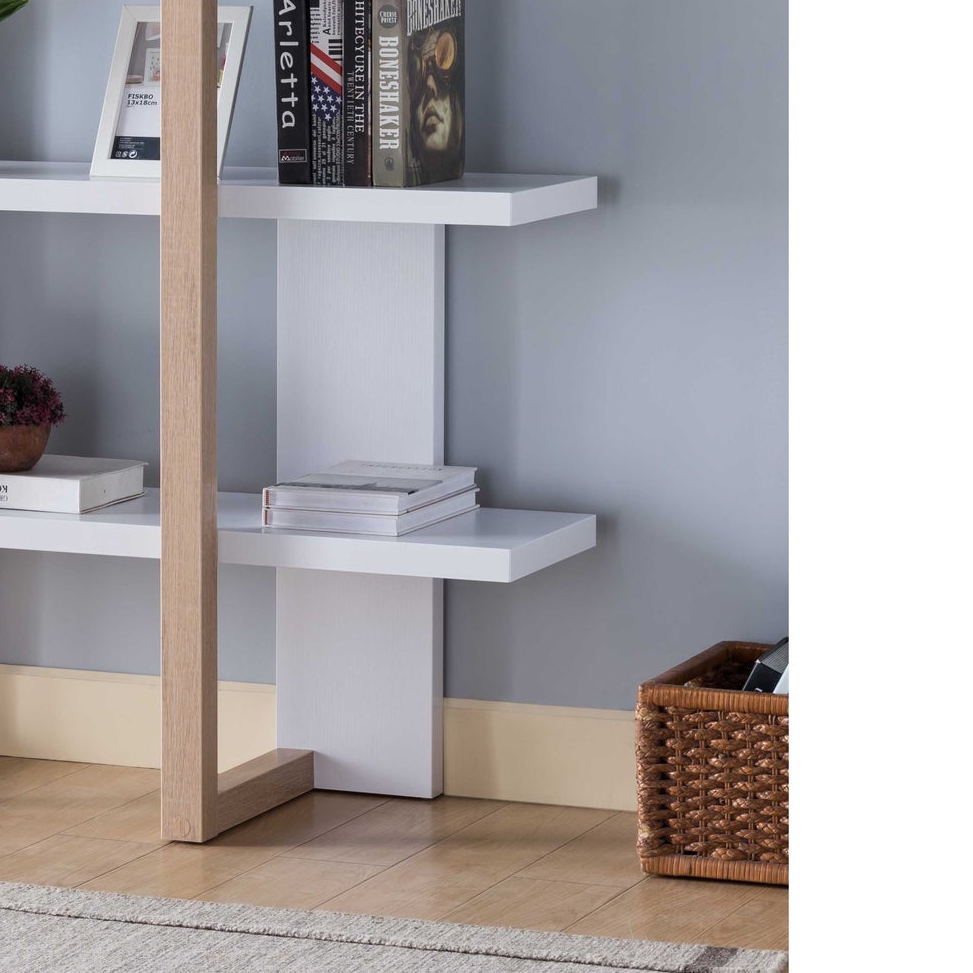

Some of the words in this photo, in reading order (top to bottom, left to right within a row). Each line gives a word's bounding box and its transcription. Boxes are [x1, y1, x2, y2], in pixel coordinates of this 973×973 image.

[346, 71, 355, 122] TWENTIETH
[355, 85, 365, 100] IN
[379, 36, 399, 150] BONESHAKER
[355, 102, 365, 133] THE
[346, 125, 355, 165] CENTURY
